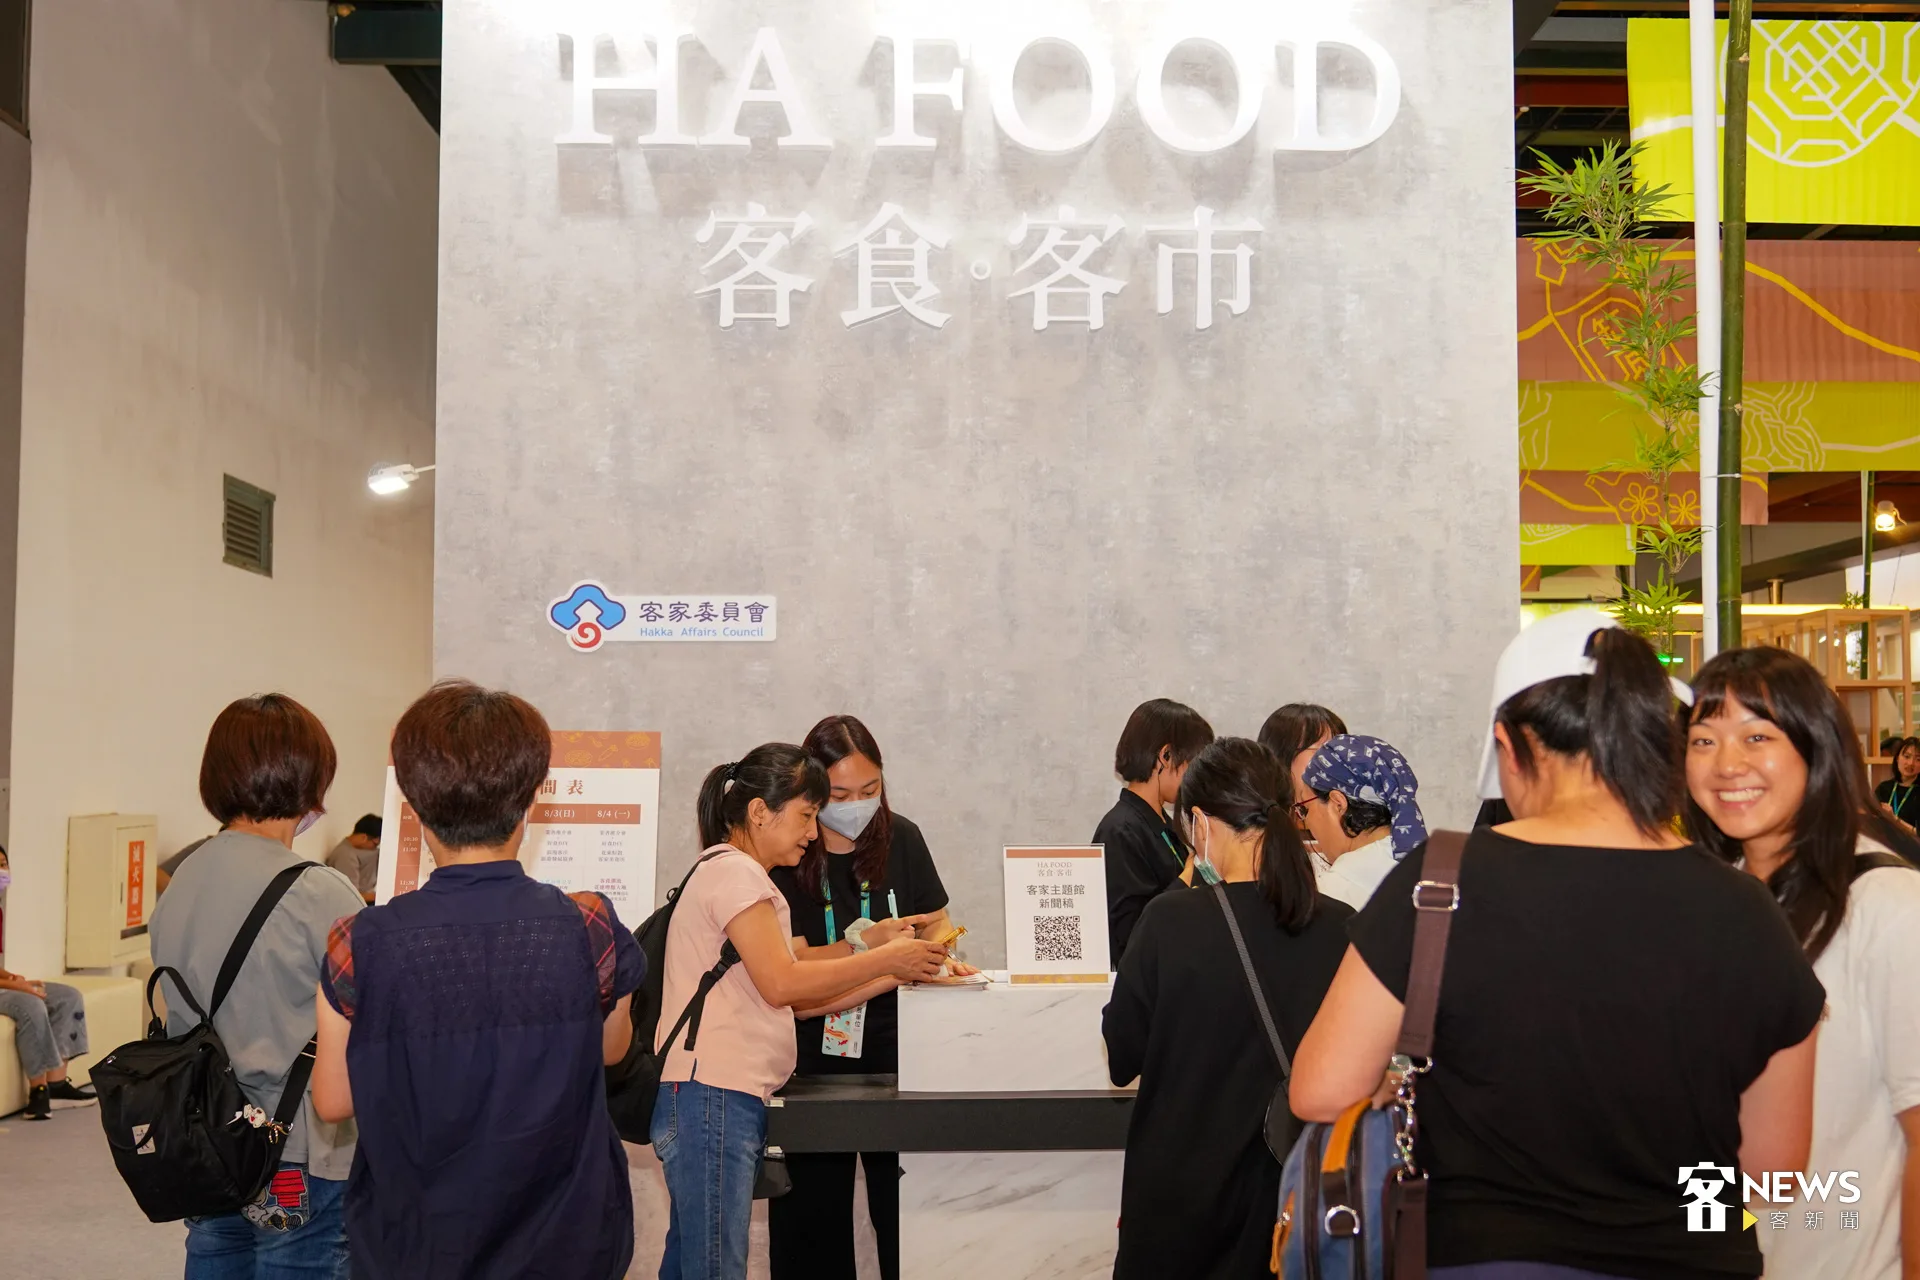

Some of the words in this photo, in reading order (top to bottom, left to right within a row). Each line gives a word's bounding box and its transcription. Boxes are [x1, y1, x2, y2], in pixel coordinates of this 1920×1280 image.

[554, 27, 833, 148] HA
[874, 34, 1402, 156] FOOD
[639, 601, 769, 623] 客家委員會
[640, 627, 673, 637] Hakka
[681, 627, 717, 637] Affairs
[723, 627, 764, 637] Council
[1026, 884, 1085, 895] 客家主題館
[1039, 898, 1074, 909] 新聞稿
